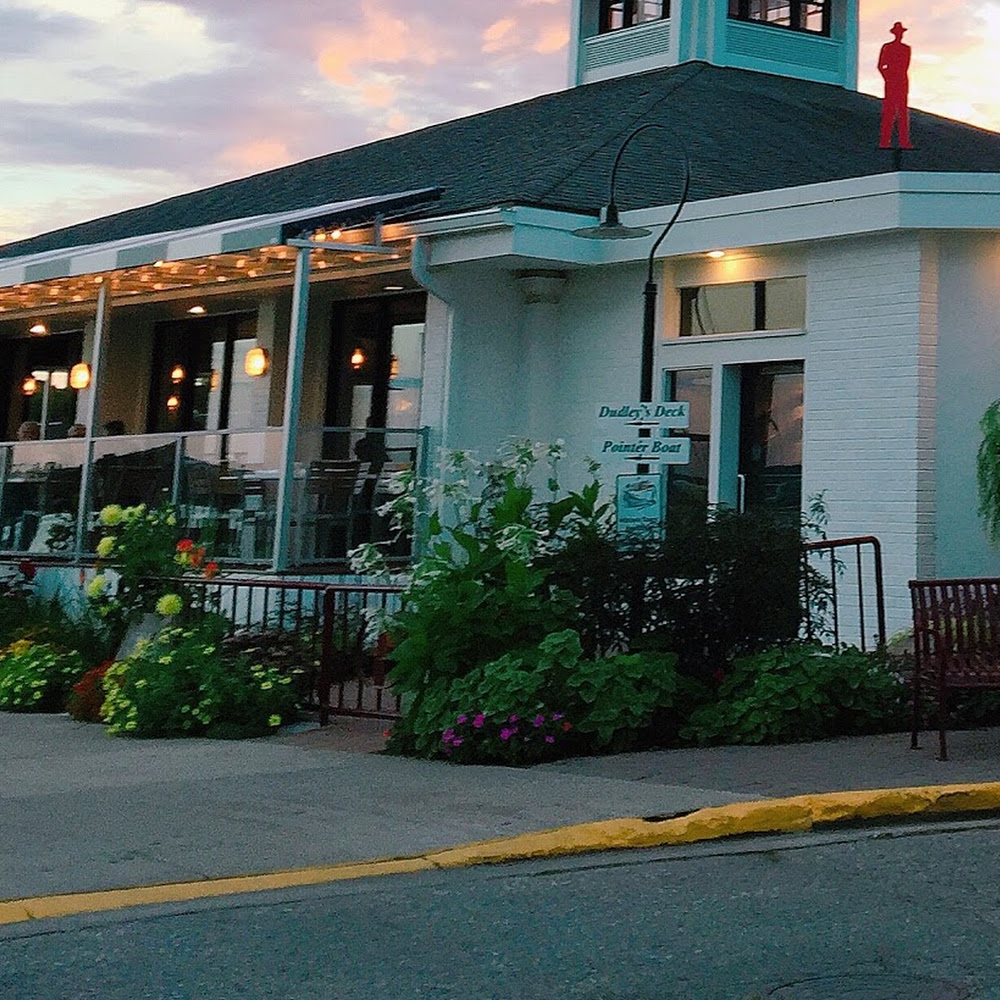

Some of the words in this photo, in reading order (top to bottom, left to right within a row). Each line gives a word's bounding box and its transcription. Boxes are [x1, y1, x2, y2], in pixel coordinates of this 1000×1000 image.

[599, 405, 651, 420] Dudley's
[654, 405, 685, 417] Deck
[602, 441, 649, 453] Pointer
[651, 441, 681, 453] Boat
